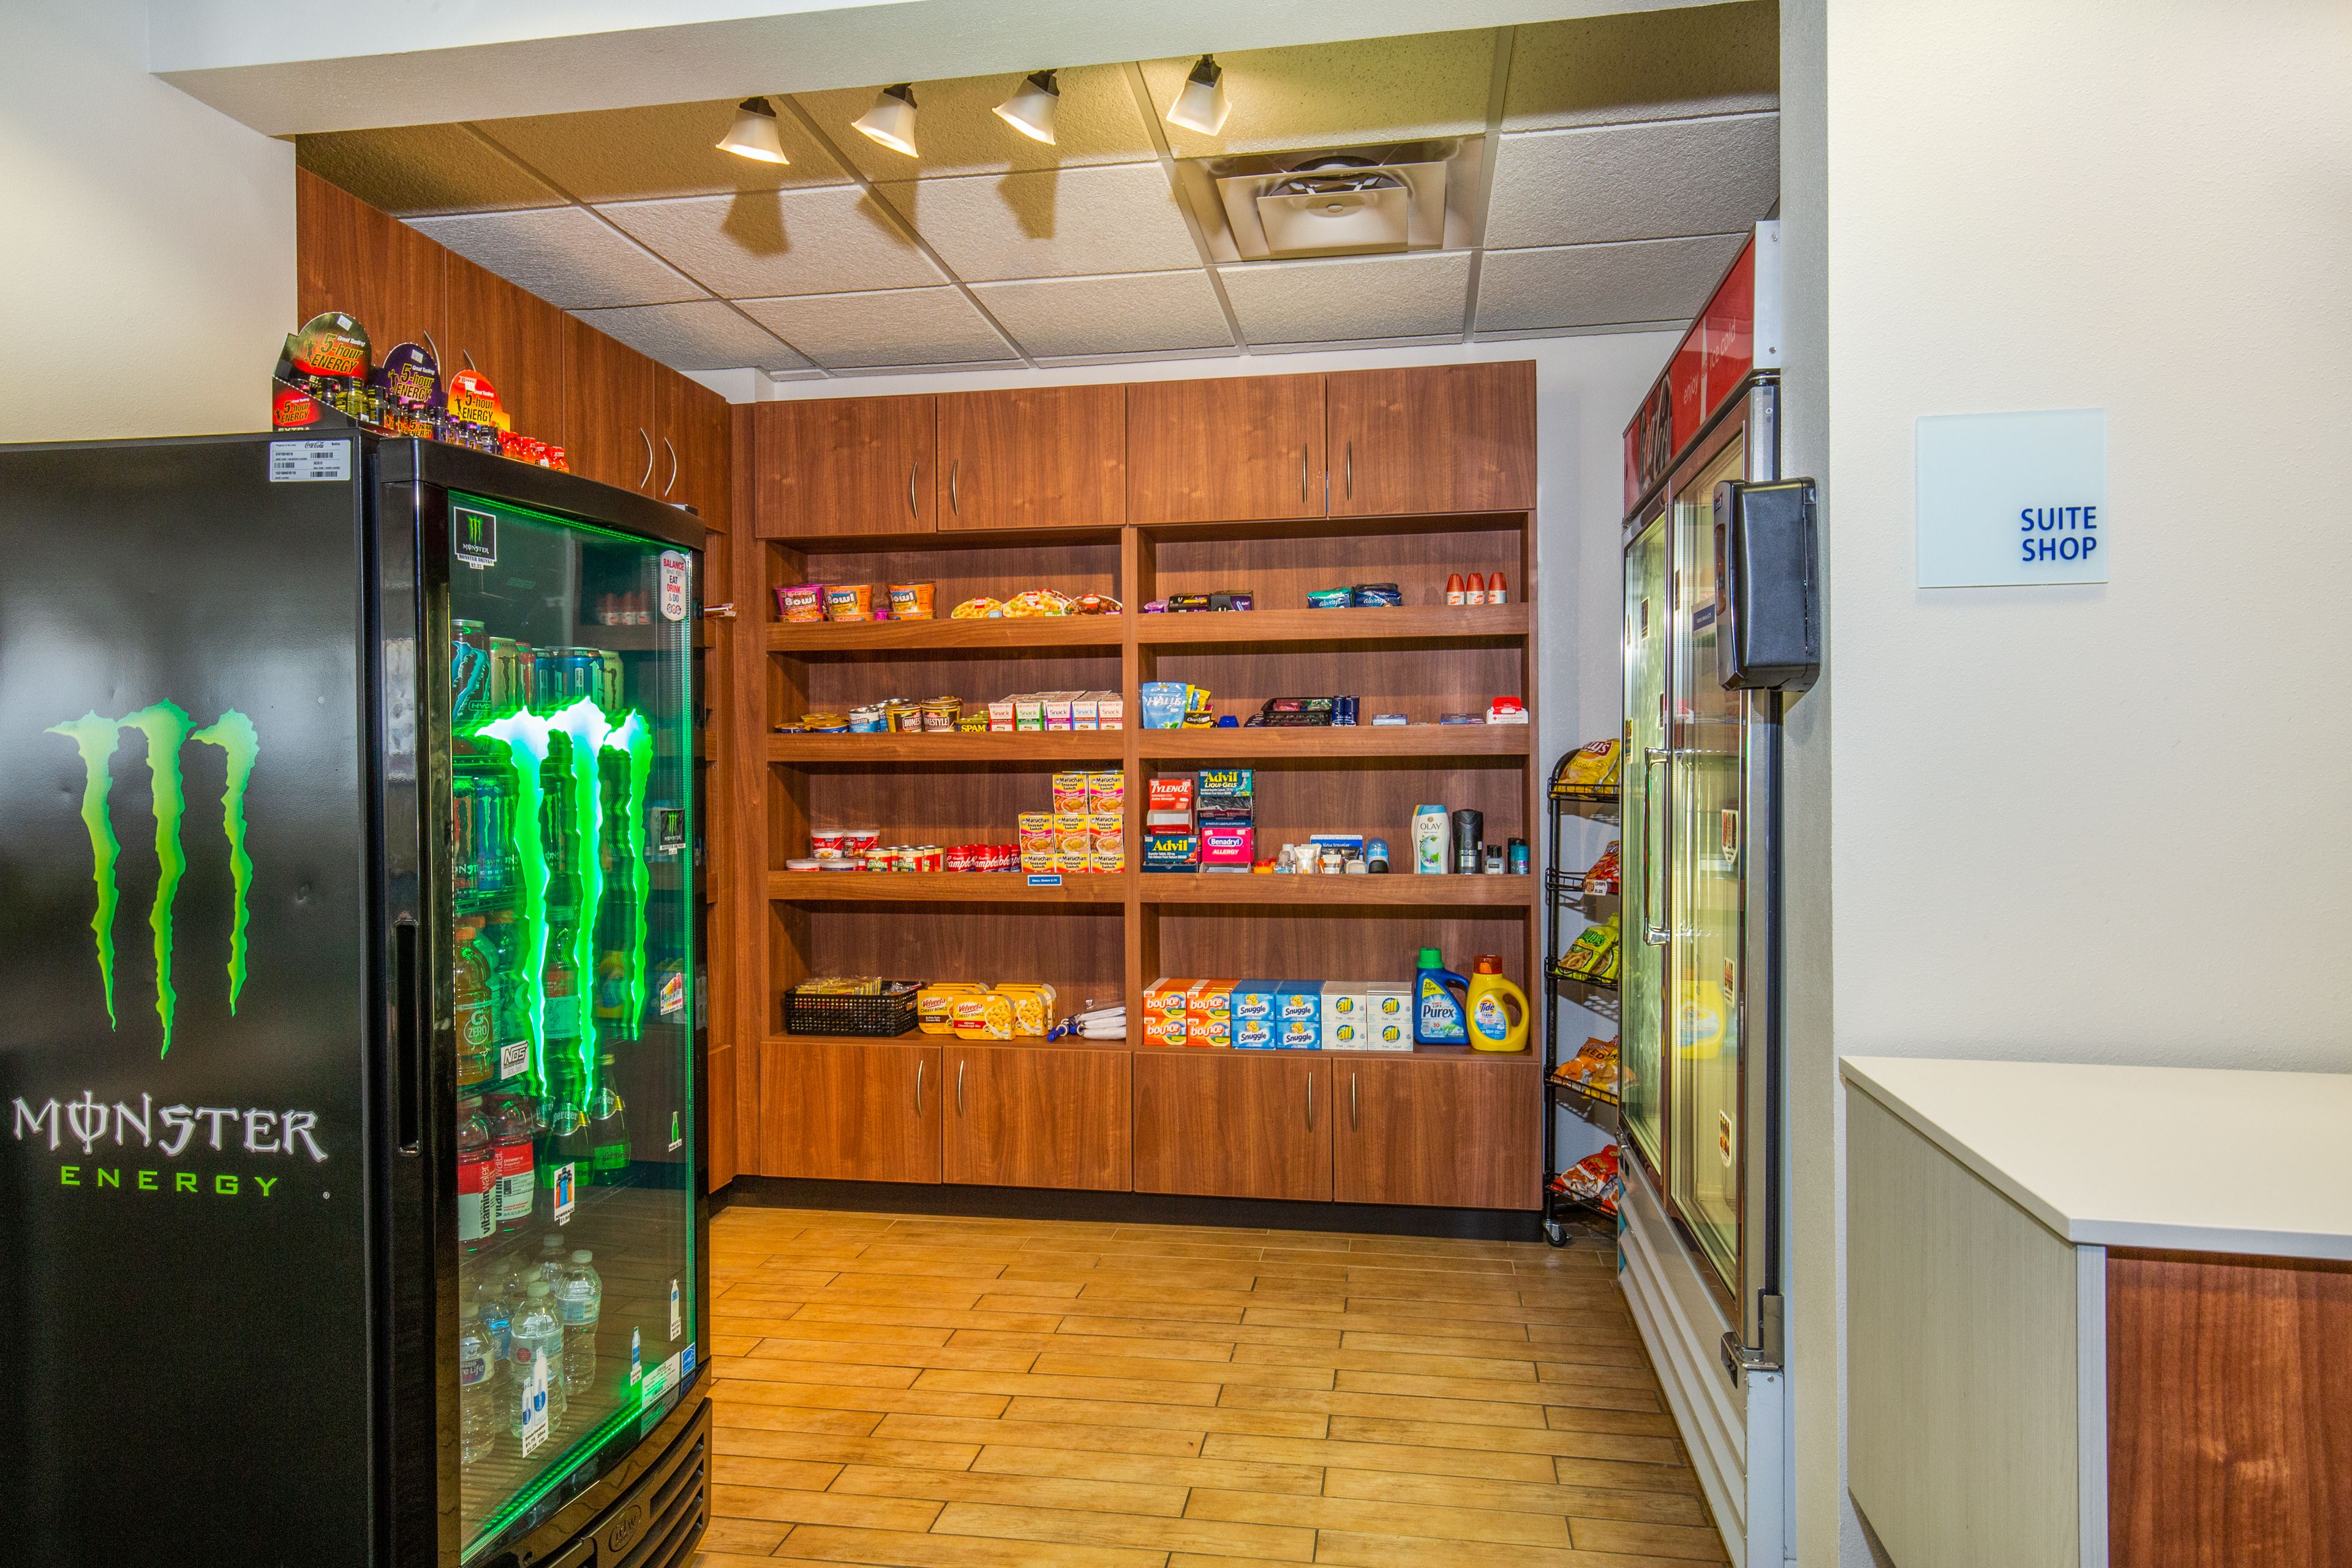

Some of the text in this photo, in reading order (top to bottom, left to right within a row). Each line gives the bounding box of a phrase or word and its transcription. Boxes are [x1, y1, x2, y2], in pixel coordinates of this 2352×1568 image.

[320, 333, 363, 360] 5-hour
[311, 354, 359, 374] ENERGY
[1684, 315, 1736, 404] enjoy ice cold
[401, 363, 434, 388] 5-hour
[396, 383, 431, 401] ENERGY
[465, 390, 494, 409] 5-hour
[284, 401, 310, 413] 5-hour
[281, 411, 309, 423] ENERGY
[462, 407, 493, 422] ENERGY
[2021, 506, 2097, 532] SUITE
[463, 543, 489, 554] MONSTER
[2022, 536, 2097, 562] SHOP
[663, 558, 684, 571] BALANCE
[667, 584, 680, 594] DRINK
[785, 594, 816, 606] Bowl
[1319, 598, 1341, 607] always
[1147, 696, 1182, 706] HALLS
[1205, 772, 1238, 782] Advil
[1152, 785, 1189, 793] TYLENOL
[1153, 840, 1188, 851] Advil
[922, 998, 946, 1008] Velveeta
[959, 1003, 982, 1012] Velveeta
[1147, 998, 1178, 1008] bounce
[1191, 998, 1222, 1009] bounce
[1337, 998, 1352, 1011] all
[1383, 999, 1398, 1012] all
[1480, 1002, 1494, 1012] Tide
[471, 1009, 484, 1025] G
[1240, 1006, 1266, 1016] Snuggle
[1285, 1007, 1311, 1016] Snuggle
[1423, 1005, 1454, 1018] Purex
[469, 1025, 487, 1038] ZERO
[1147, 1023, 1179, 1036] bounce
[1191, 1024, 1223, 1036] bounce
[1338, 1026, 1352, 1039] all
[1384, 1027, 1399, 1039] all
[1240, 1033, 1267, 1042] Snuggle
[1286, 1034, 1312, 1043] Snuggle
[503, 1042, 527, 1066] NOS
[12, 1090, 328, 1163] MONSTER
[61, 1166, 278, 1196] ENERGY
[556, 1207, 574, 1219] POWERADE
[470, 1363, 484, 1376] Life
[525, 1422, 546, 1442] Smartwater
